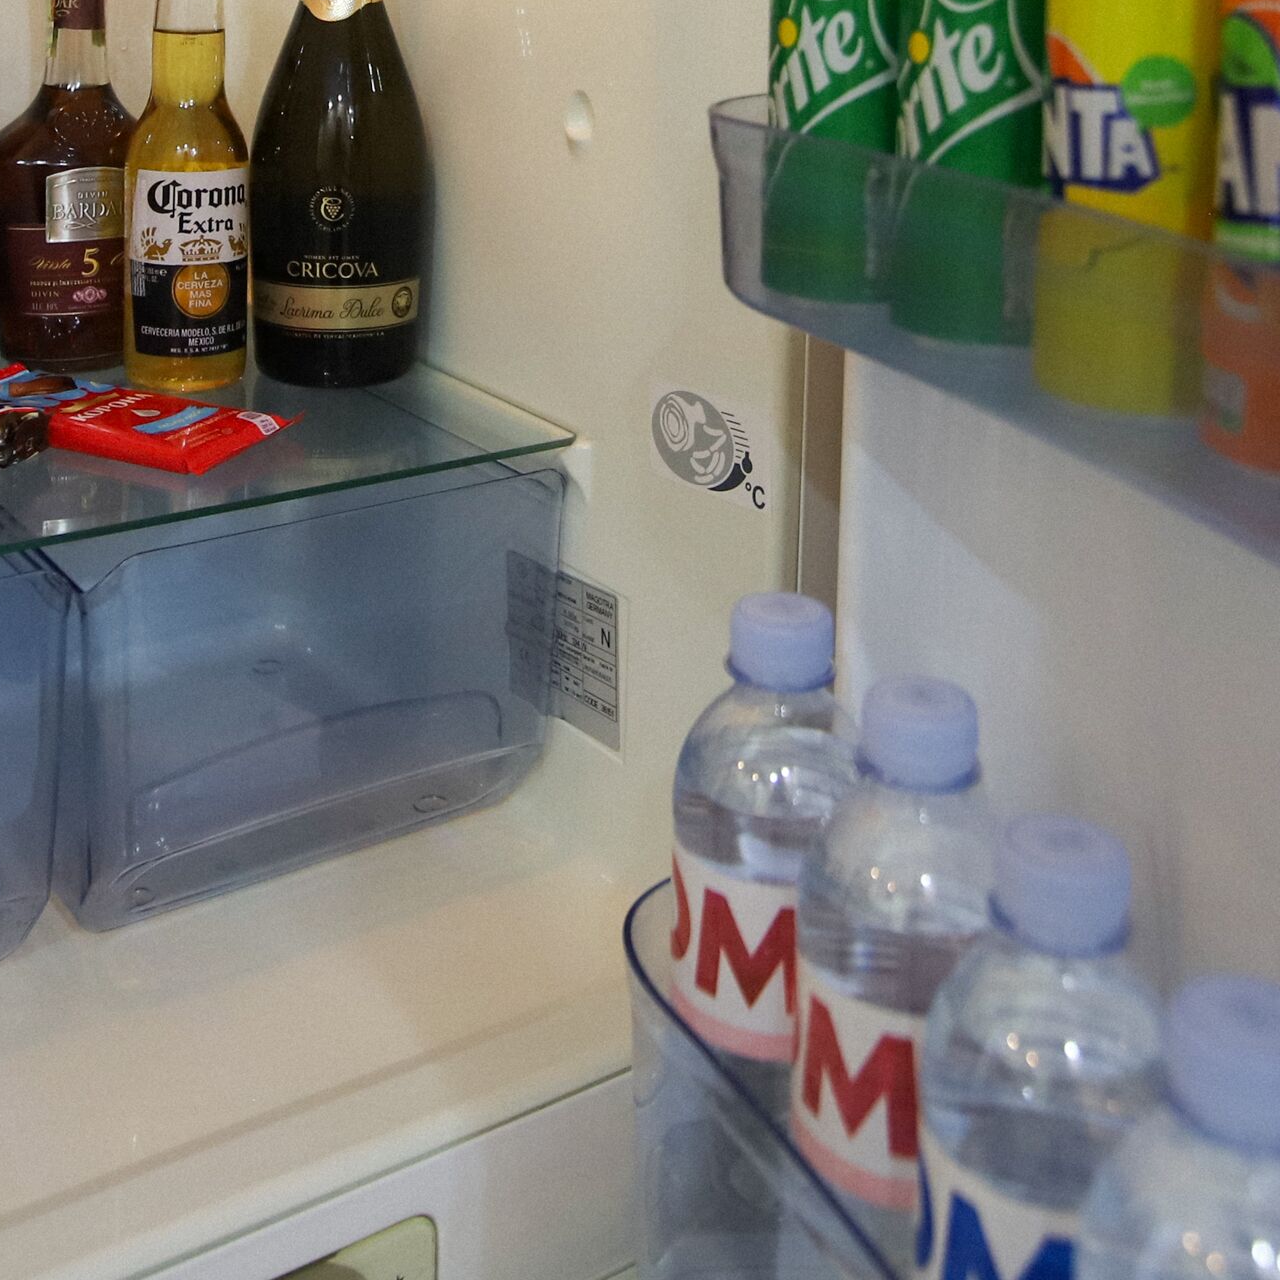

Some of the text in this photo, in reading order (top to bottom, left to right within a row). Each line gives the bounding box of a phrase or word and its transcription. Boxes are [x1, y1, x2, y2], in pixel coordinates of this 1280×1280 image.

[770, 5, 863, 132] rite
[897, 17, 1004, 160] rite
[1042, 85, 1156, 181] NTA
[146, 179, 246, 218] Corona
[52, 201, 117, 223] BARDA
[178, 211, 234, 234] Extra
[81, 247, 100, 277] 5
[286, 261, 379, 279] CRICOVA
[177, 279, 223, 289] CERVEZA
[194, 271, 208, 281] LA
[189, 300, 212, 308] FINA
[190, 290, 212, 299] MAS
[280, 296, 334, 319] Lacrima
[339, 297, 384, 318] Dulce
[141, 325, 180, 337] CERVECERIA
[600, 627, 611, 649] N
